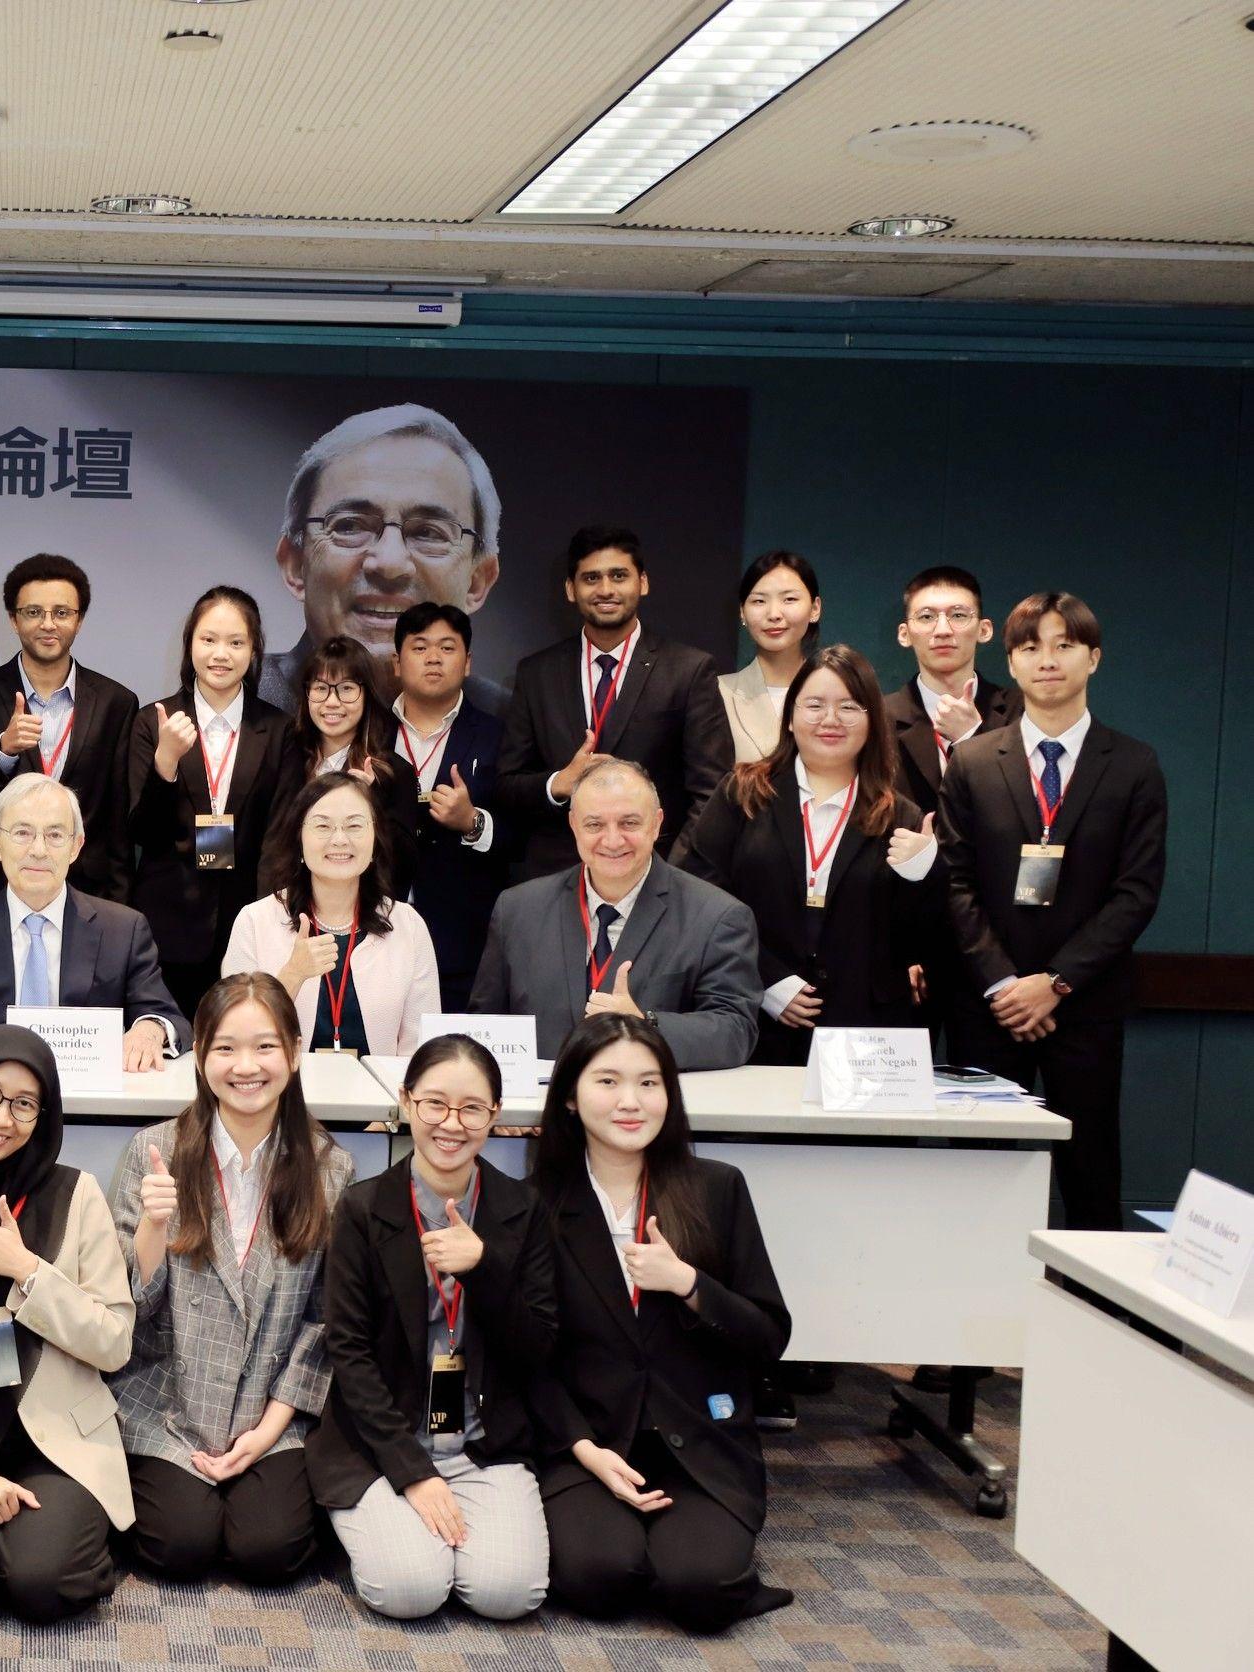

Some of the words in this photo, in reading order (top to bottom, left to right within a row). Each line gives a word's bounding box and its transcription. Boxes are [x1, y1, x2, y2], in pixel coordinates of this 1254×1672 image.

[199, 854, 216, 862] VIP
[29, 1023, 99, 1036] Christopher
[491, 1044, 528, 1054] CHEN
[431, 1412, 447, 1423] VIP
